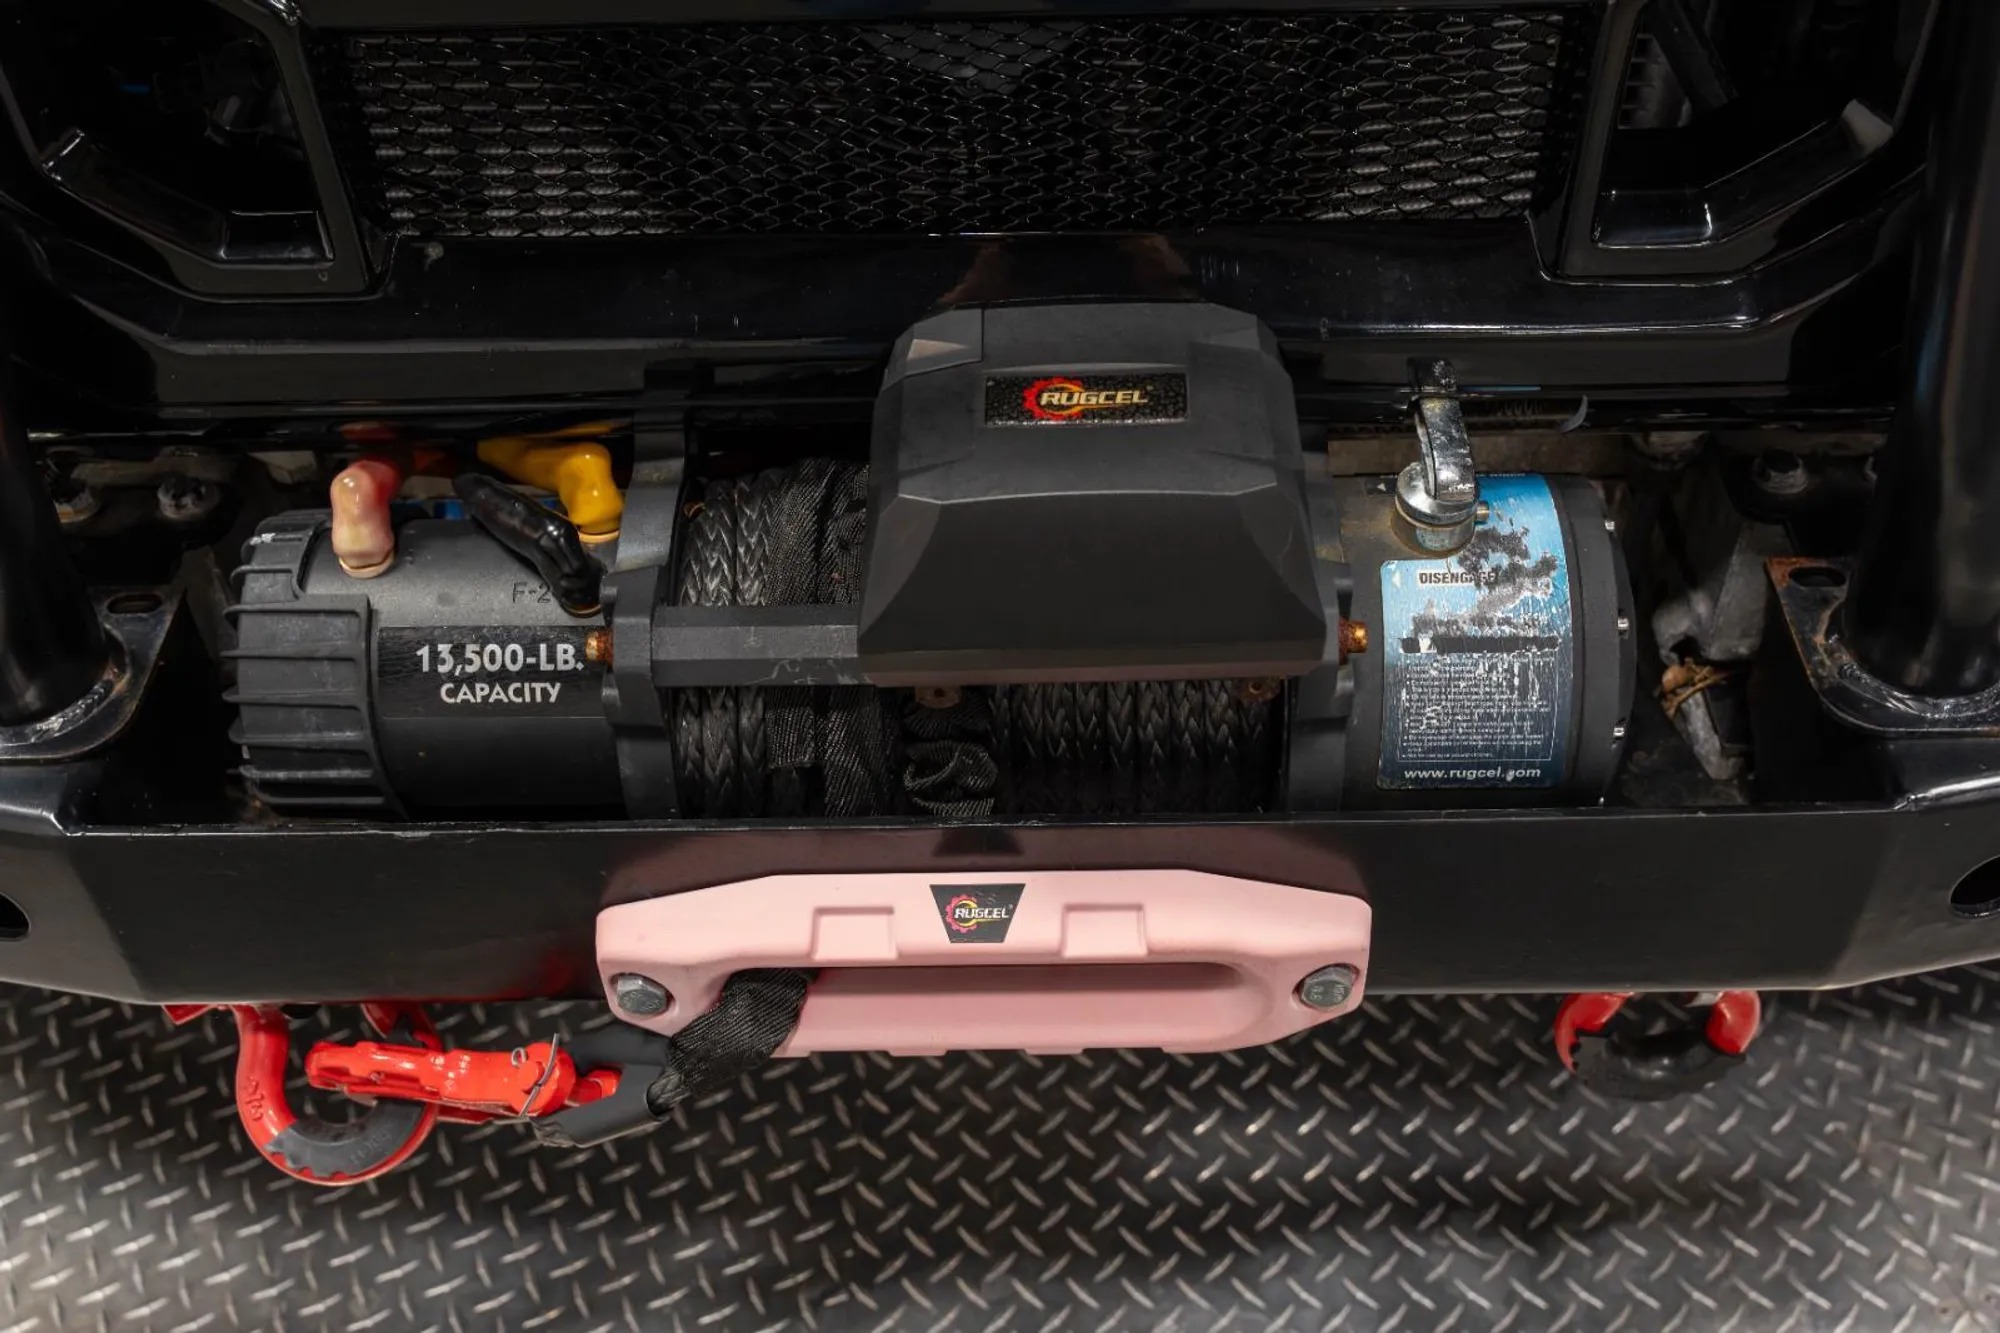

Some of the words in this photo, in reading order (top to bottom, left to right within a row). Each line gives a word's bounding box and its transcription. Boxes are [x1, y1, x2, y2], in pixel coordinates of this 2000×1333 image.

[1039, 390, 1149, 406] RUGCEL
[415, 642, 585, 677] 13,500-LB.
[440, 682, 561, 704] CAPACITY
[953, 906, 1010, 919] RUGCEL
